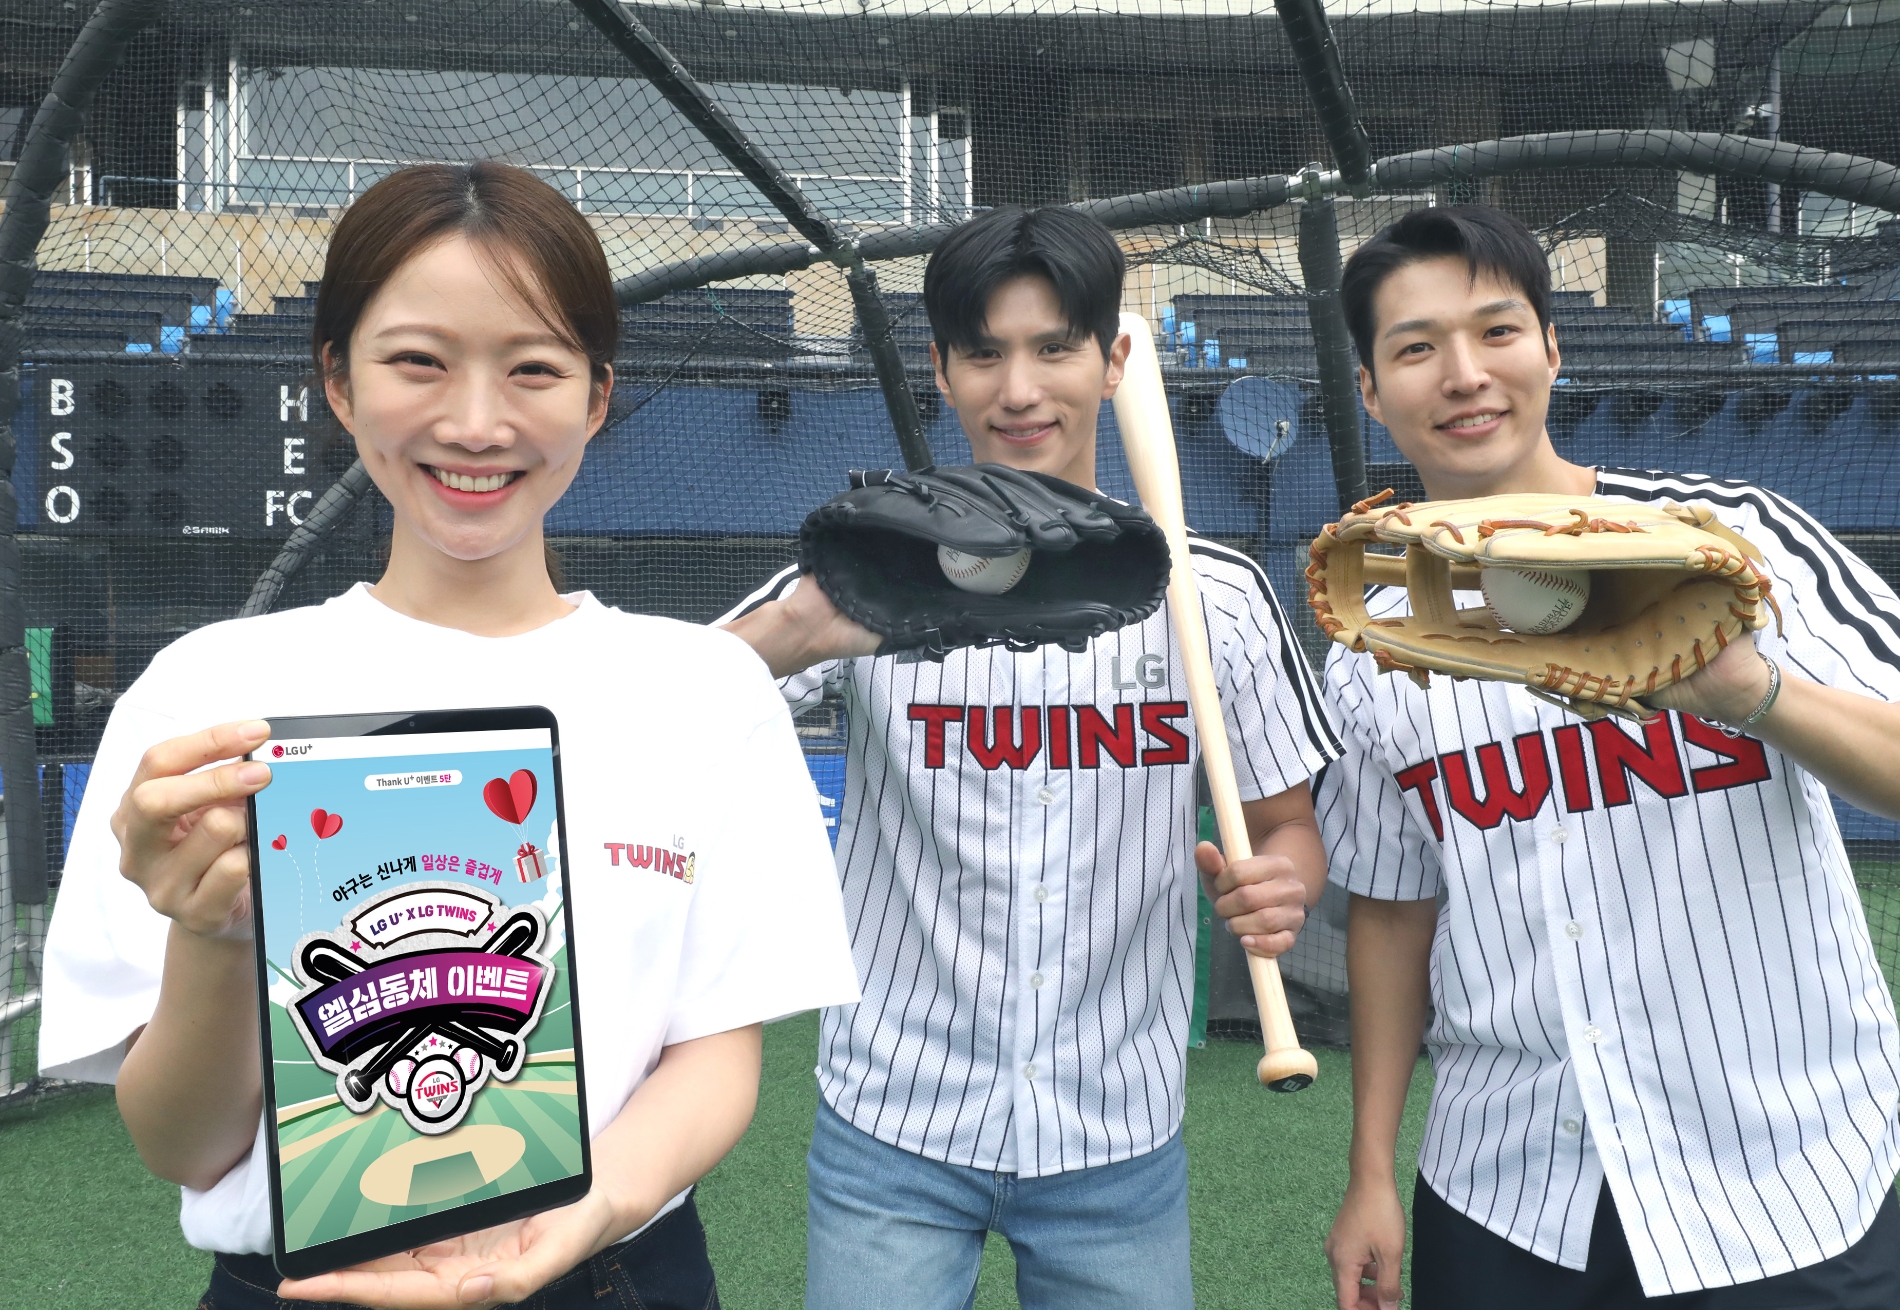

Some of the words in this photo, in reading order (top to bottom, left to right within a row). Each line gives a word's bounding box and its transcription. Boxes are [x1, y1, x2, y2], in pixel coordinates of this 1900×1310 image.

[50, 378, 75, 416] B
[280, 385, 308, 422] H
[50, 432, 74, 470] S
[284, 438, 305, 474] E
[45, 486, 81, 524] O
[265, 490, 313, 526] FC
[1111, 653, 1166, 690] LG
[907, 701, 1189, 770] TWINS
[376, 777, 402, 787] Thank
[416, 775, 439, 785] 이벤트
[439, 773, 452, 783] 5탄
[1393, 709, 1772, 842] TWINS
[672, 834, 685, 850] LG
[332, 873, 374, 902] 야구는
[376, 855, 417, 881] 신나게
[421, 854, 461, 872] 일상은
[464, 858, 503, 886] 즐겁게
[604, 842, 687, 880] TWINS
[369, 918, 388, 936] LG
[405, 907, 417, 921] X
[418, 905, 434, 918] LG
[436, 904, 477, 922] TWINS
[317, 966, 439, 1038] 엘심동체
[446, 965, 530, 1002] 이벤트
[415, 1080, 459, 1100] TWINS
